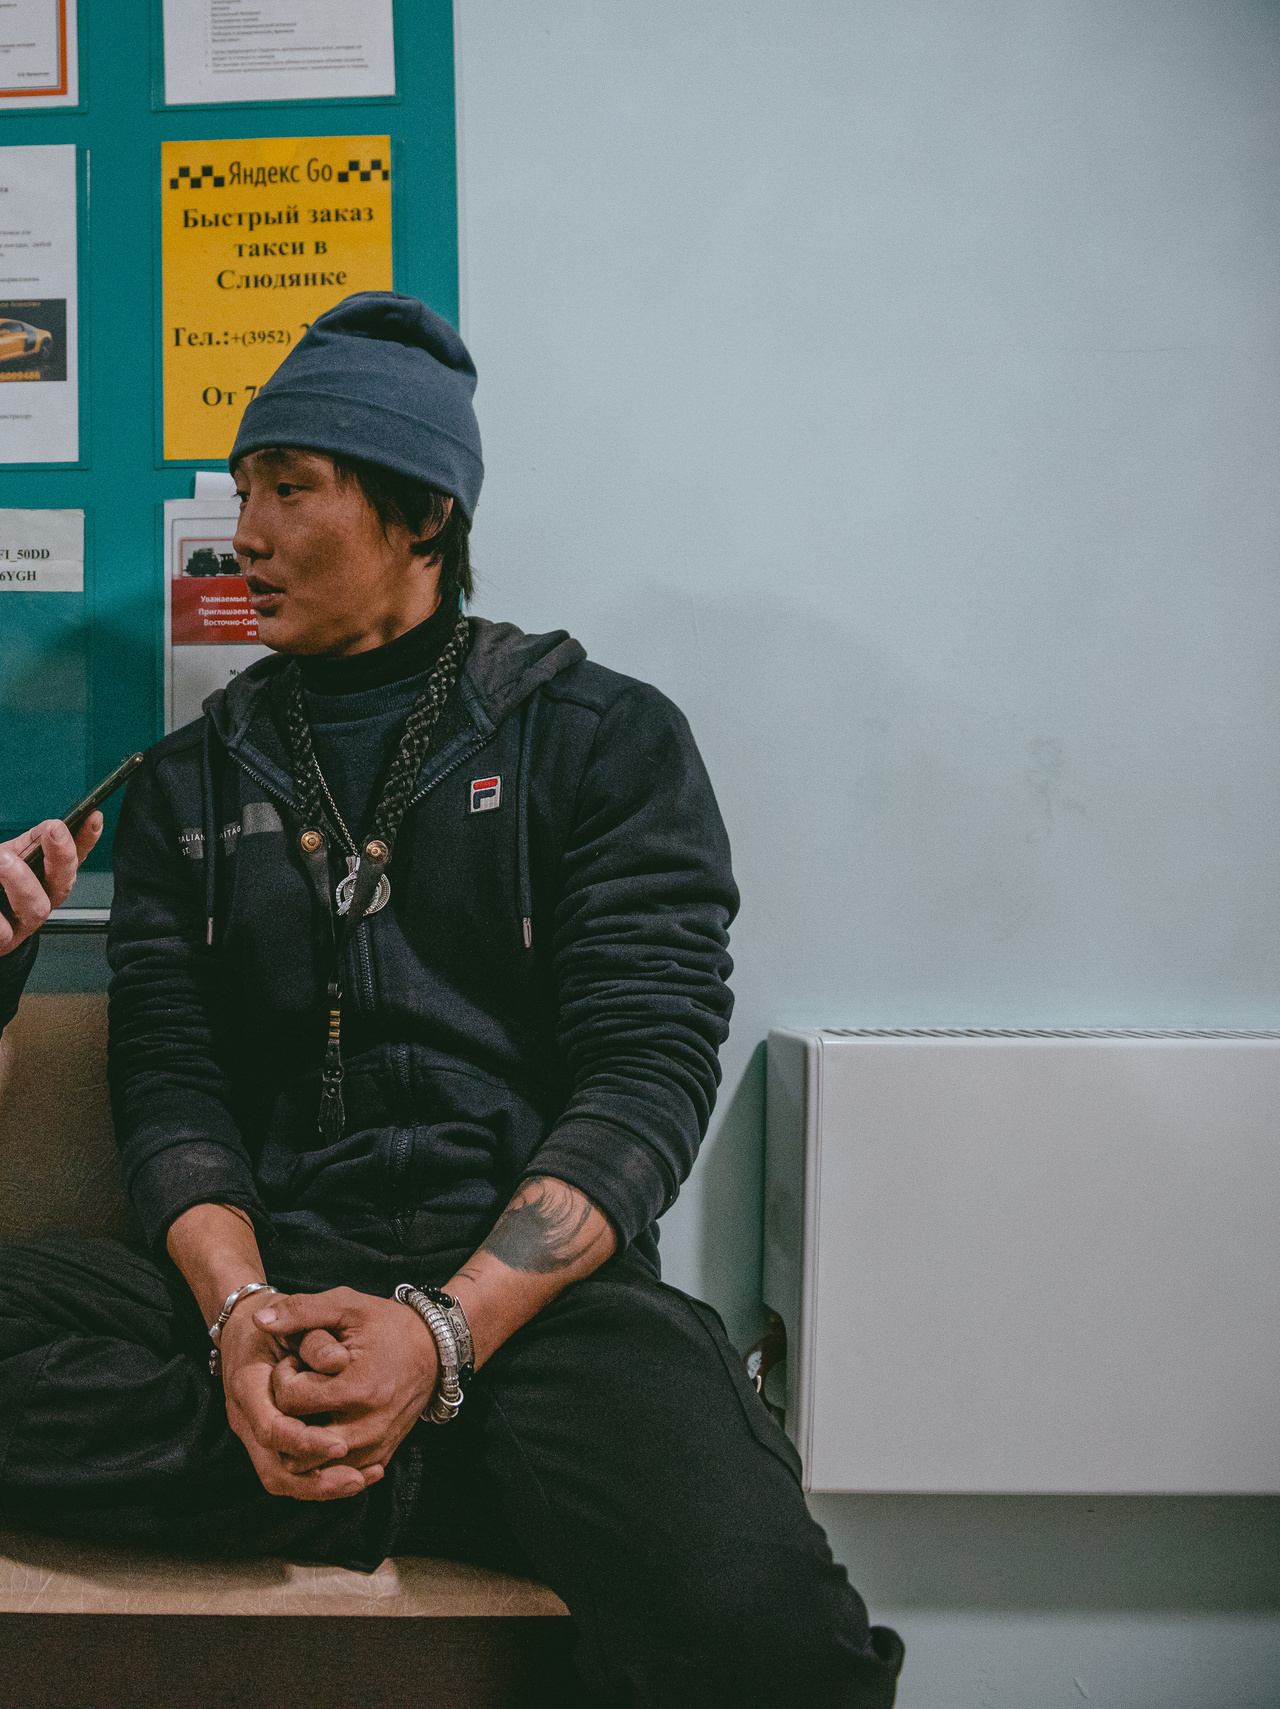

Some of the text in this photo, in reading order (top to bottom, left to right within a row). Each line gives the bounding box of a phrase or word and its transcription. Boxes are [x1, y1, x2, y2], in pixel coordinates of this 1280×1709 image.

[228, 158, 332, 187] Яндекс Go
[183, 205, 374, 231] Быстрый заказ
[233, 241, 327, 258] такси в
[216, 270, 348, 290] Слюдянке
[202, 386, 238, 406] От
[200, 595, 247, 603] Уважаемые
[198, 608, 248, 616] Приглашаем
